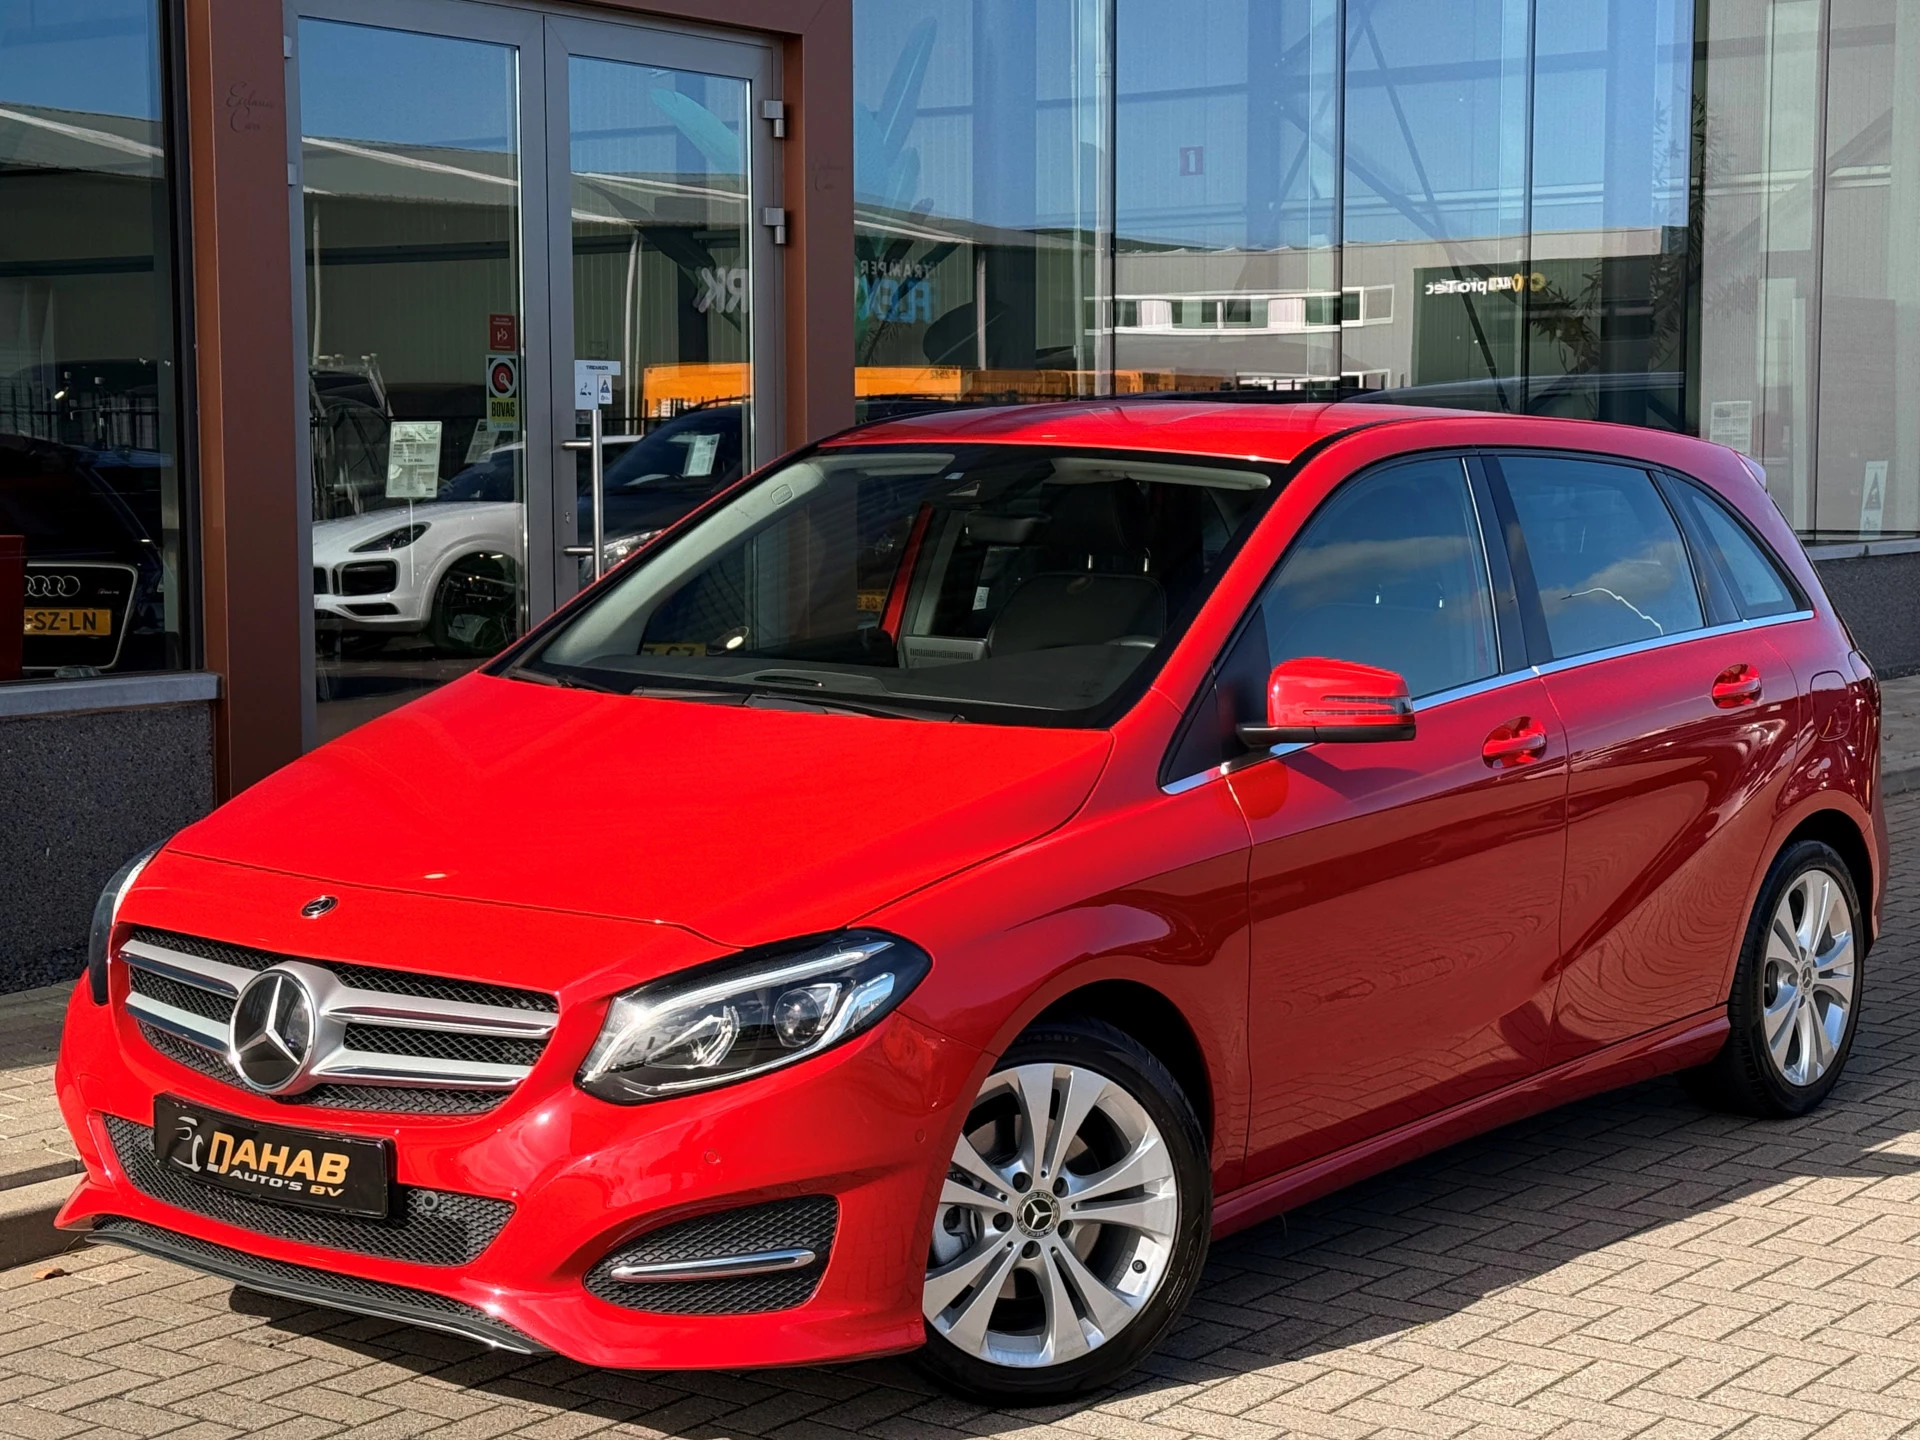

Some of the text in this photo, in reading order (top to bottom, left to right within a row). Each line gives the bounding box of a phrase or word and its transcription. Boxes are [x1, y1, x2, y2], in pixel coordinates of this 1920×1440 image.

[491, 401, 515, 418] BOVAG
[207, 1131, 350, 1185] DAHAB
[229, 1168, 345, 1197] AUTO'S BV
